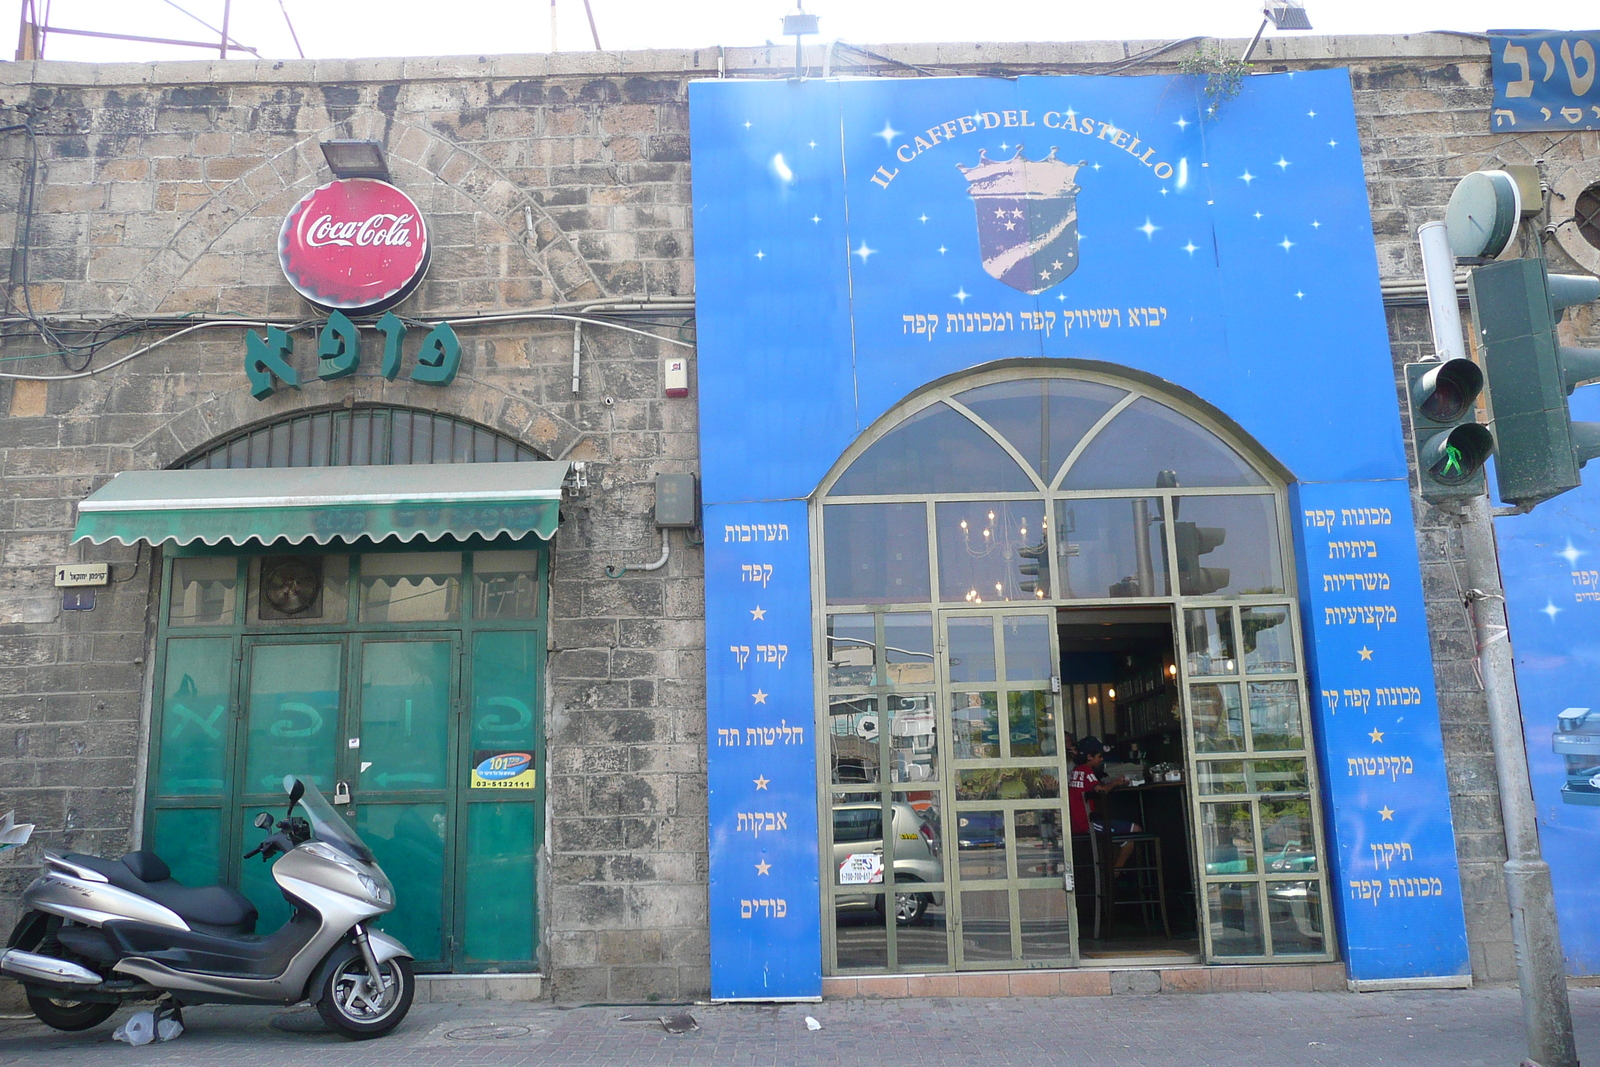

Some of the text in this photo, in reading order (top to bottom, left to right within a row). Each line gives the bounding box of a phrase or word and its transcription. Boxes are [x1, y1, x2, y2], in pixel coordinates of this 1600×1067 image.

[870, 110, 1174, 190] IL CAFFE DEL CASTELLO
[306, 213, 415, 248] Coca-Cola
[902, 307, 1167, 342] יבוא ושיווק קפה ומכונות קפה
[244, 309, 463, 401] פופא
[724, 523, 789, 543] תערובות
[1305, 507, 1392, 533] מכונות קפה
[1328, 541, 1378, 558] ביתיות
[58, 569, 65, 581] 1
[741, 563, 773, 588] קפה
[1323, 573, 1390, 591] משרדיות
[1571, 570, 1599, 590] קפה
[75, 593, 81, 606] 1
[1325, 605, 1397, 630] מקצועיות
[730, 644, 788, 670] קפה קר
[1322, 687, 1421, 715] מכונות קפה קר
[717, 719, 804, 746] חליטות תה
[490, 757, 509, 771] 101
[1347, 756, 1413, 782] מקינטות
[736, 811, 788, 838] אבקות
[1371, 842, 1413, 870] תיקון
[1349, 878, 1442, 906] מכונות קפה
[740, 898, 787, 919] פודים
